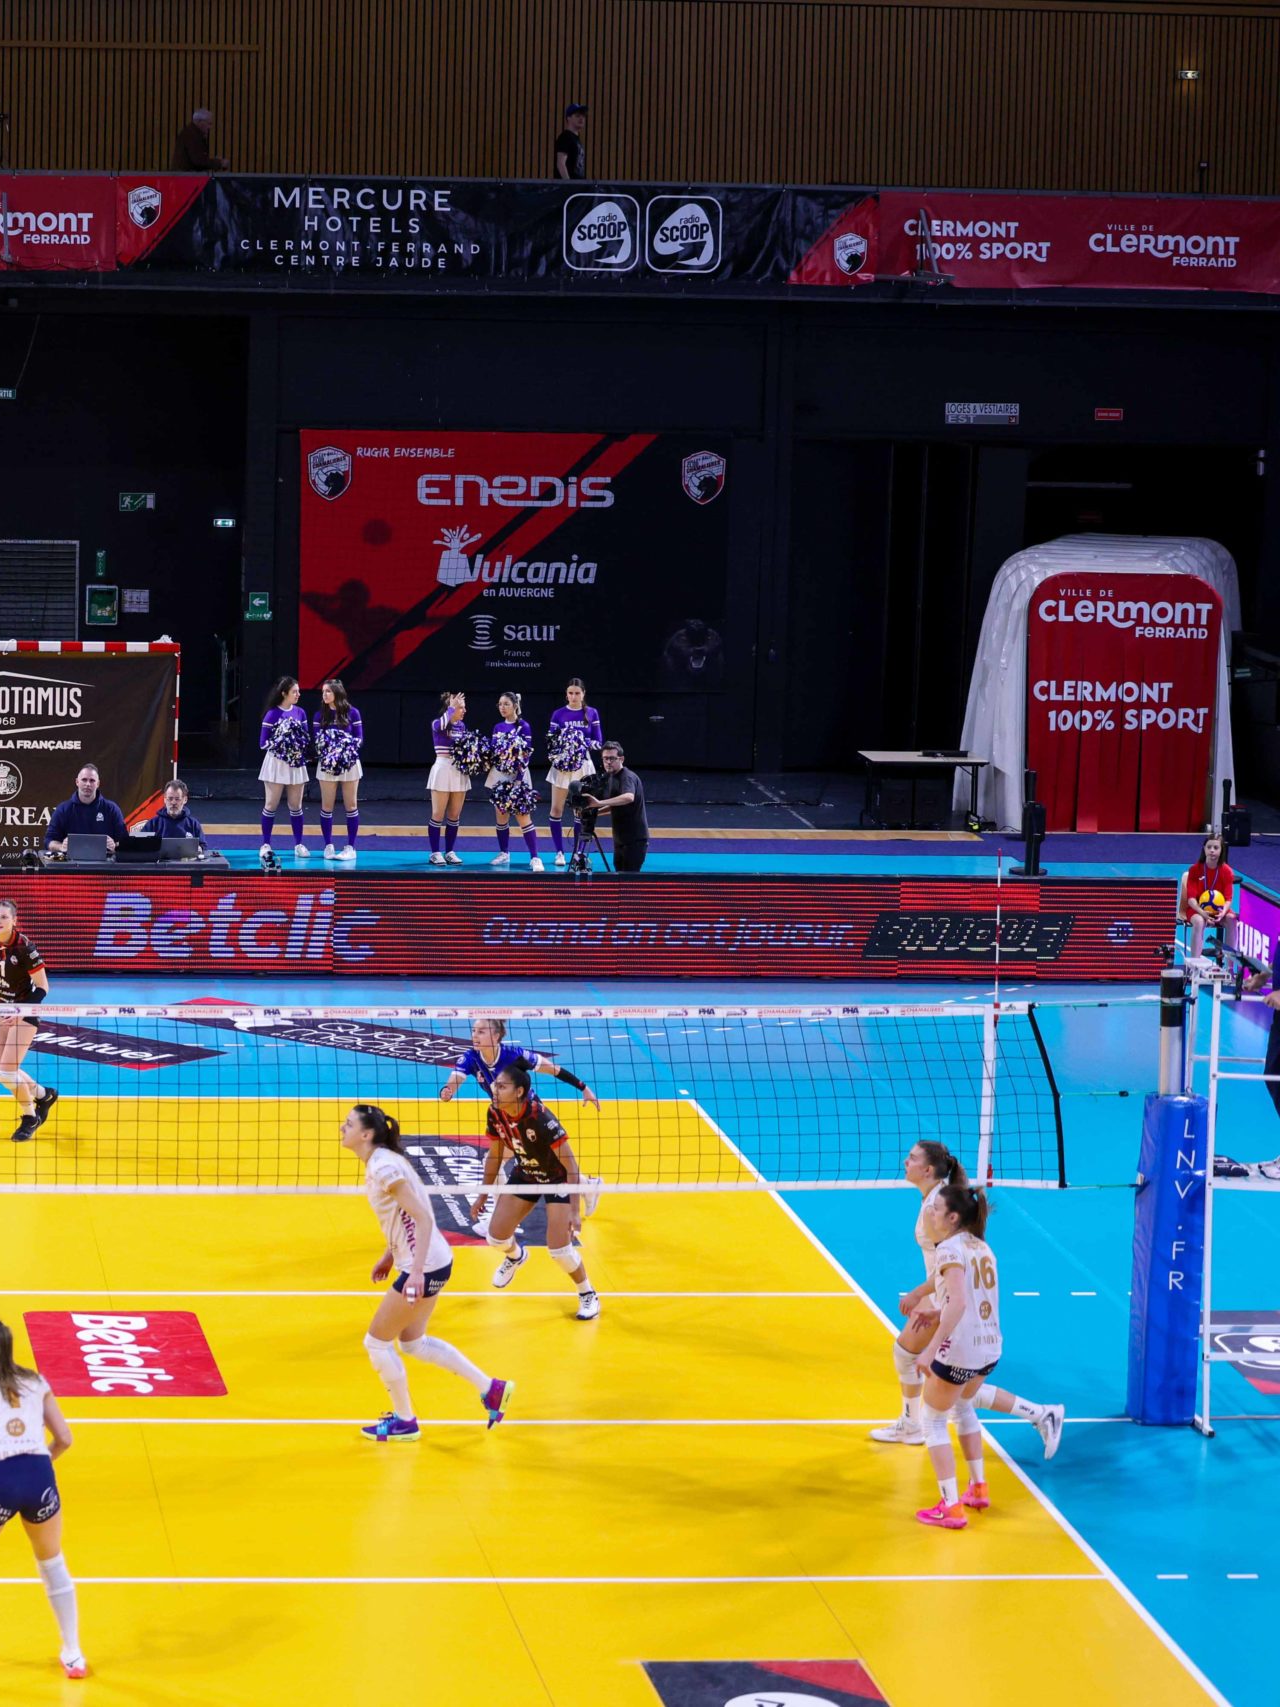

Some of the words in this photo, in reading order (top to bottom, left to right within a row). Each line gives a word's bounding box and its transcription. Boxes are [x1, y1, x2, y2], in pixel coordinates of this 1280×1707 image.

[274, 186, 452, 212] MERCURE
[304, 216, 421, 234] HOTELS
[597, 213, 618, 222] radio
[679, 215, 700, 225] radio
[577, 221, 627, 241] SCOOP
[659, 223, 710, 243] SCOOP
[1107, 224, 1136, 232] VILLE
[979, 241, 1051, 263] SPORT
[275, 254, 360, 268] CENTRE
[376, 256, 447, 270] JAUDE
[947, 403, 970, 414] LOGES
[979, 404, 1018, 414] VESTIAIRES
[948, 414, 976, 423] EST
[357, 447, 390, 458] RUGIR
[394, 448, 455, 458] ENSEMBLE
[462, 554, 598, 585] Vulcania
[483, 589, 496, 597] en
[498, 588, 555, 598] AUVERGNE
[1059, 589, 1092, 597] VILLE
[1100, 589, 1114, 597] DE
[503, 624, 560, 641] saur
[1033, 680, 1173, 703] CLERMONT
[1048, 709, 1115, 731] 100%
[1124, 707, 1209, 733] SPORT
[17, 740, 82, 751] FRANÇAISE
[94, 888, 381, 961] Betclic
[119, 1007, 136, 1015] PHA
[698, 1008, 715, 1016] PHA
[842, 1007, 859, 1015] PHA
[32, 1031, 178, 1062] Mutuel
[971, 1256, 996, 1290] 16
[71, 1312, 174, 1394] Betclic
